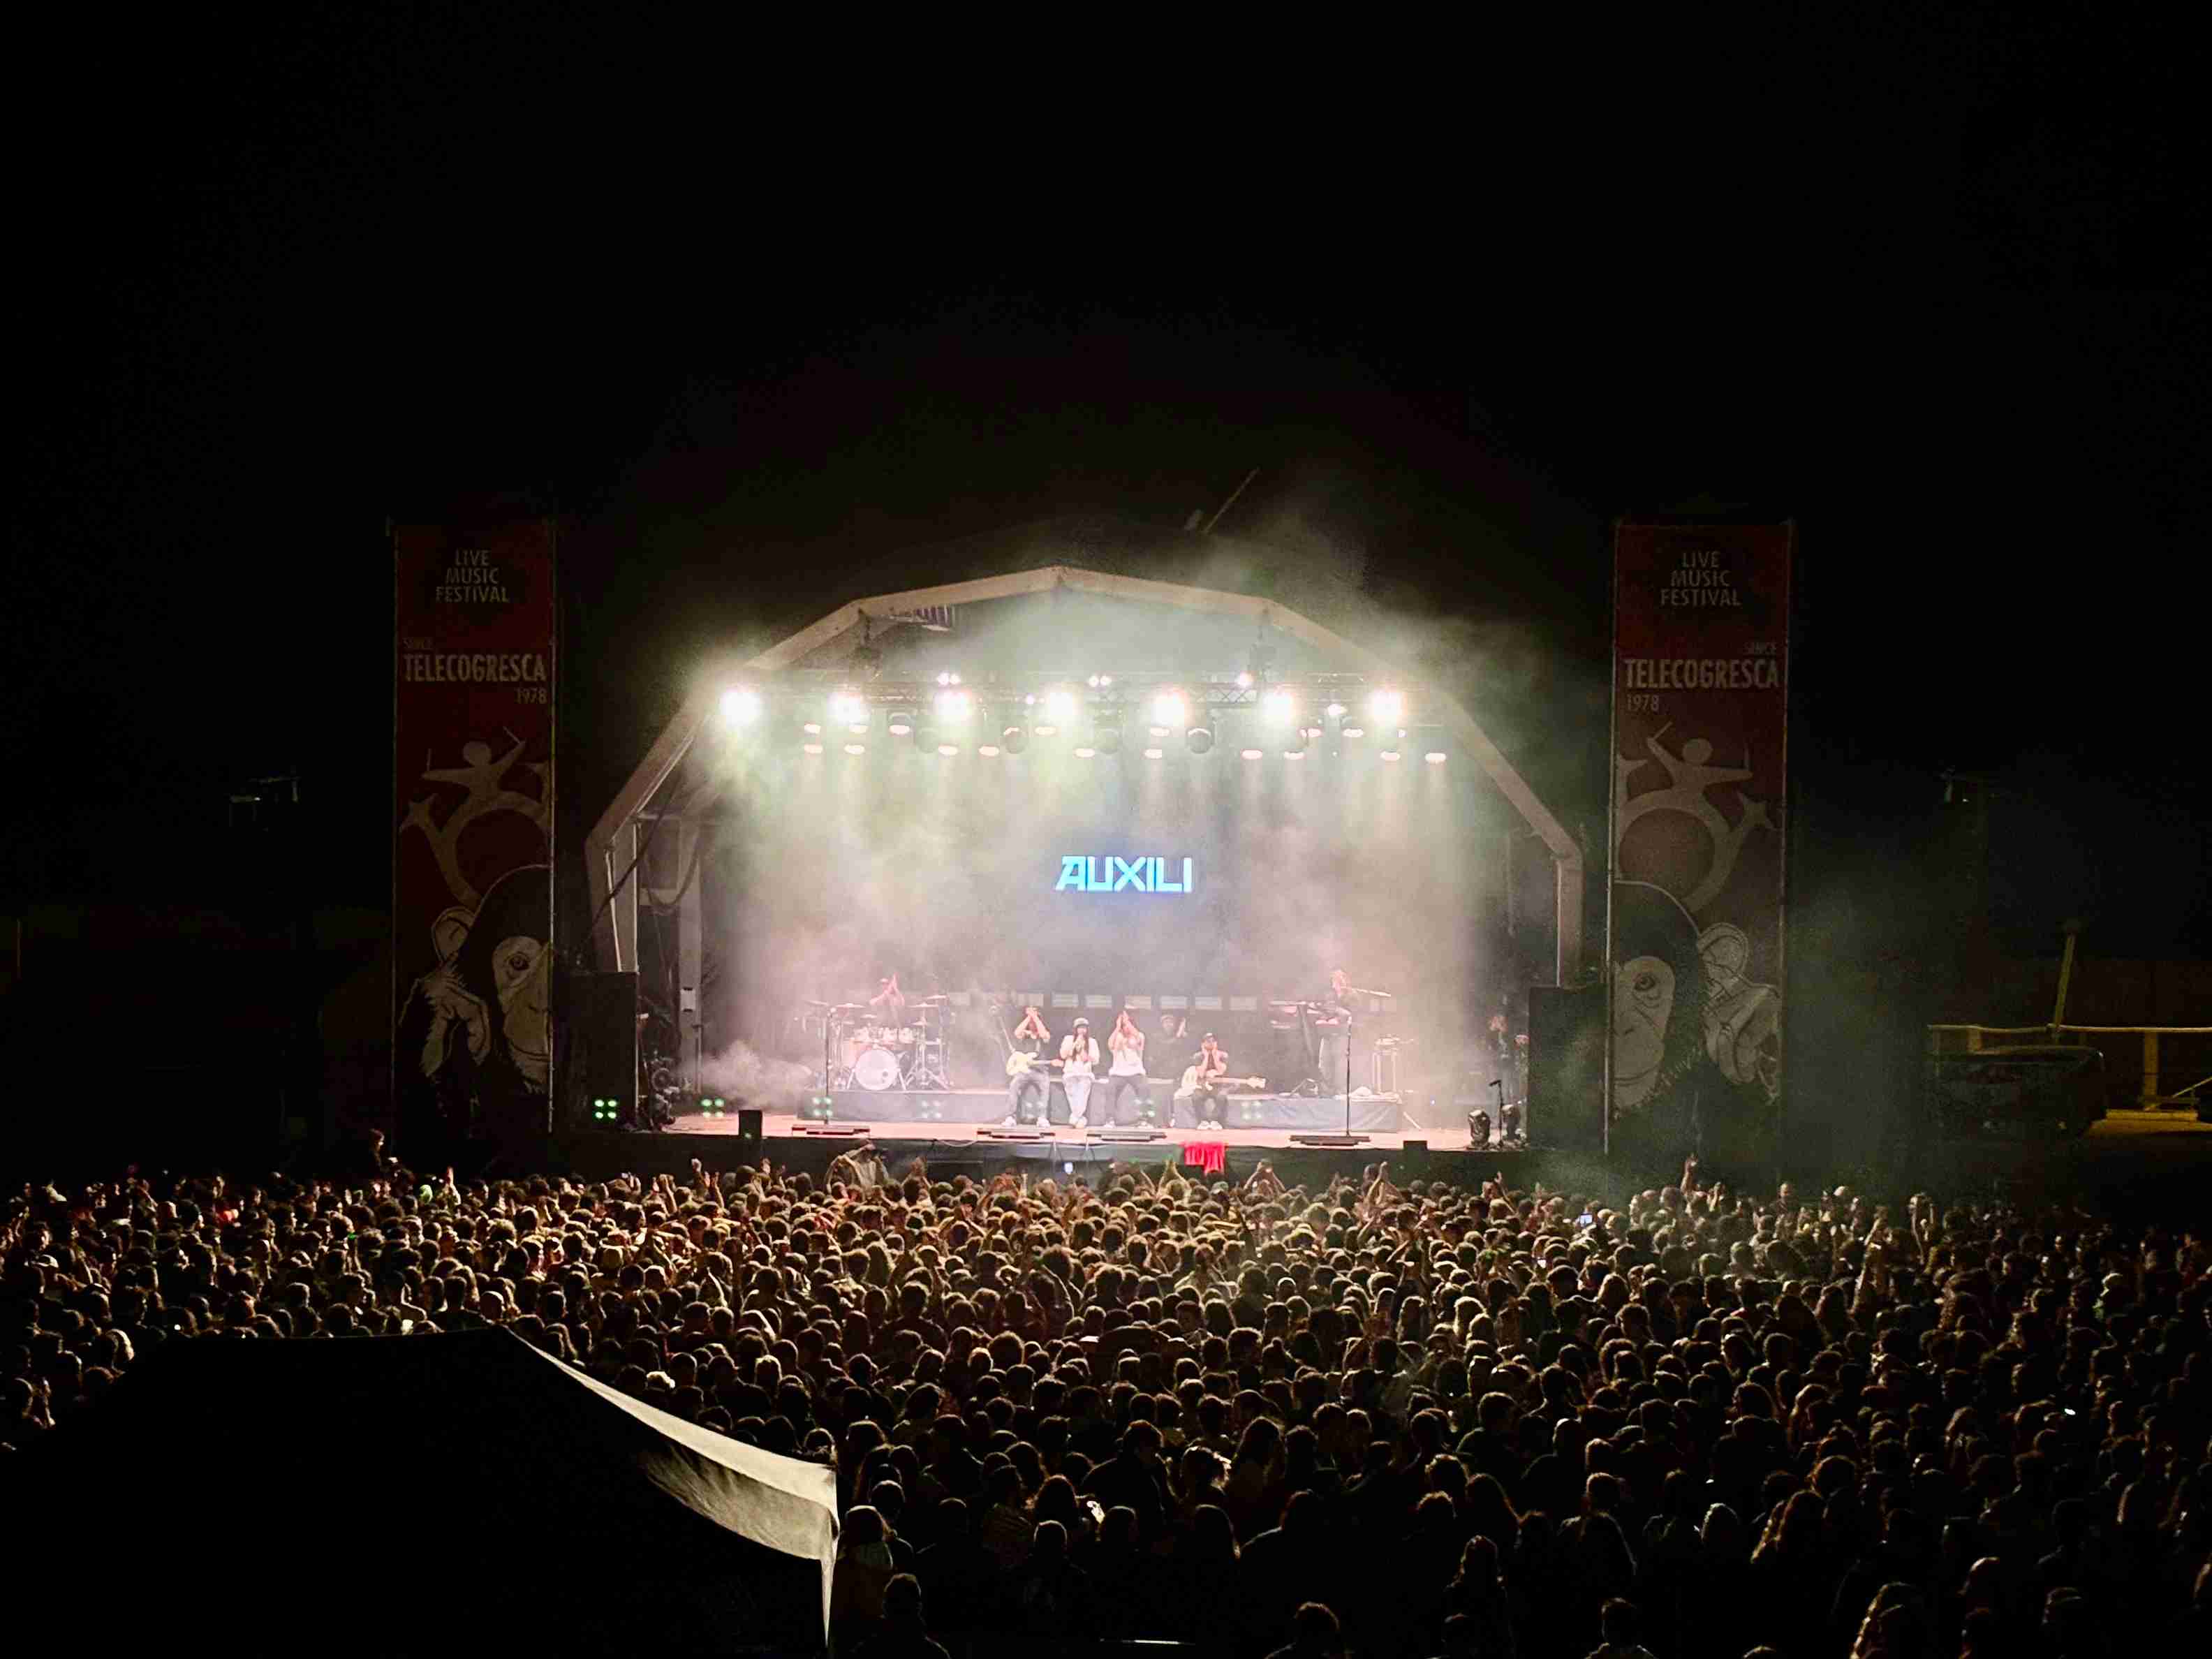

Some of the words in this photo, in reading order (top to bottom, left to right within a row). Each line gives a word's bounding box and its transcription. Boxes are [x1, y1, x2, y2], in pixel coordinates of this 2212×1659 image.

[455, 547, 490, 567] LIVE
[1681, 550, 1720, 568] LIVE
[445, 567, 500, 584] MUSIC
[1671, 569, 1731, 587] MUSIC
[435, 586, 509, 604] FESTIVAL
[1660, 589, 1743, 608] FESTIVAL
[403, 653, 548, 682] TELECOGRESCA
[1624, 658, 1780, 690] TELECOGRESCA
[515, 686, 548, 704] 1978
[1626, 694, 1659, 711] 1978
[1055, 855, 1193, 892] AUXILI
